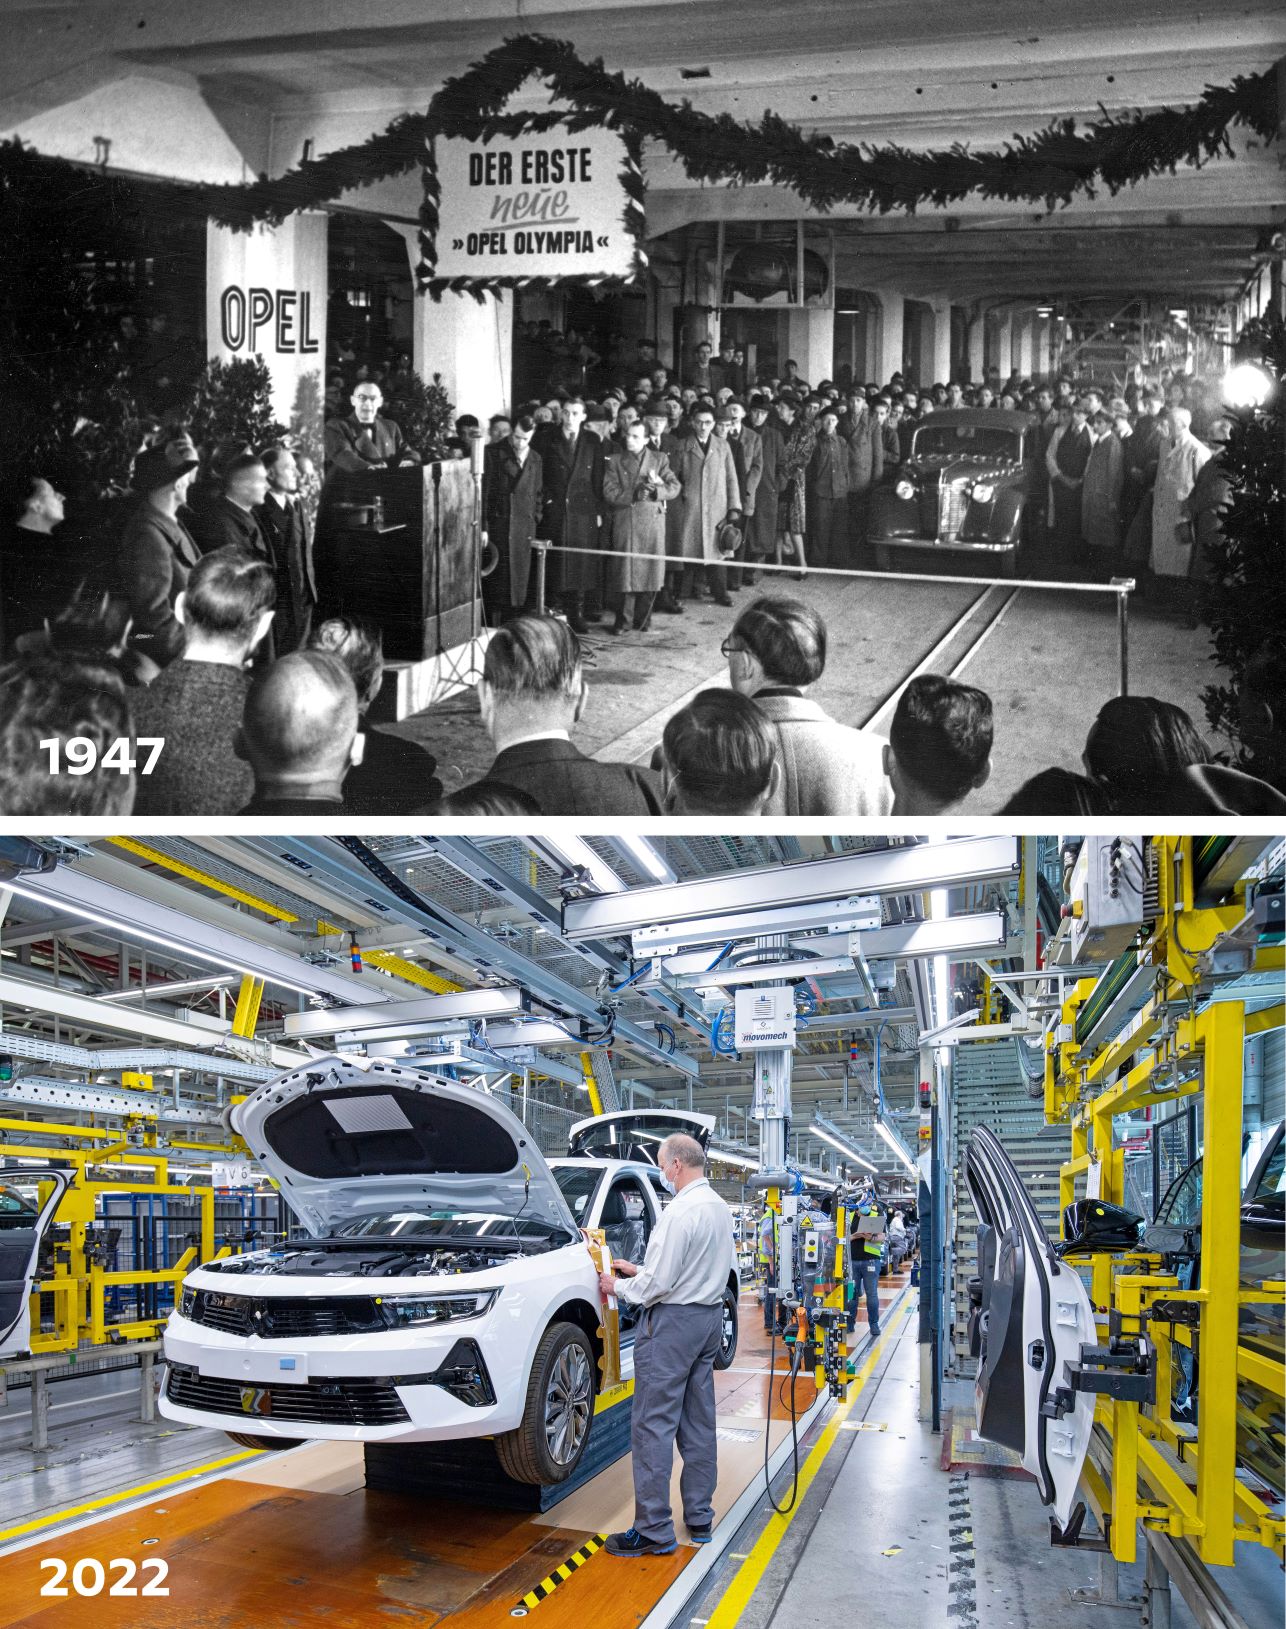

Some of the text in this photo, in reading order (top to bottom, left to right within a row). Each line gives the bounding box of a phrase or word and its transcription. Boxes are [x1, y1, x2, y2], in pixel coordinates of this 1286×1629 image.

[469, 148, 592, 186] DER ERSTE
[220, 284, 319, 354] OPEL
[743, 1032, 787, 1041] movomech
